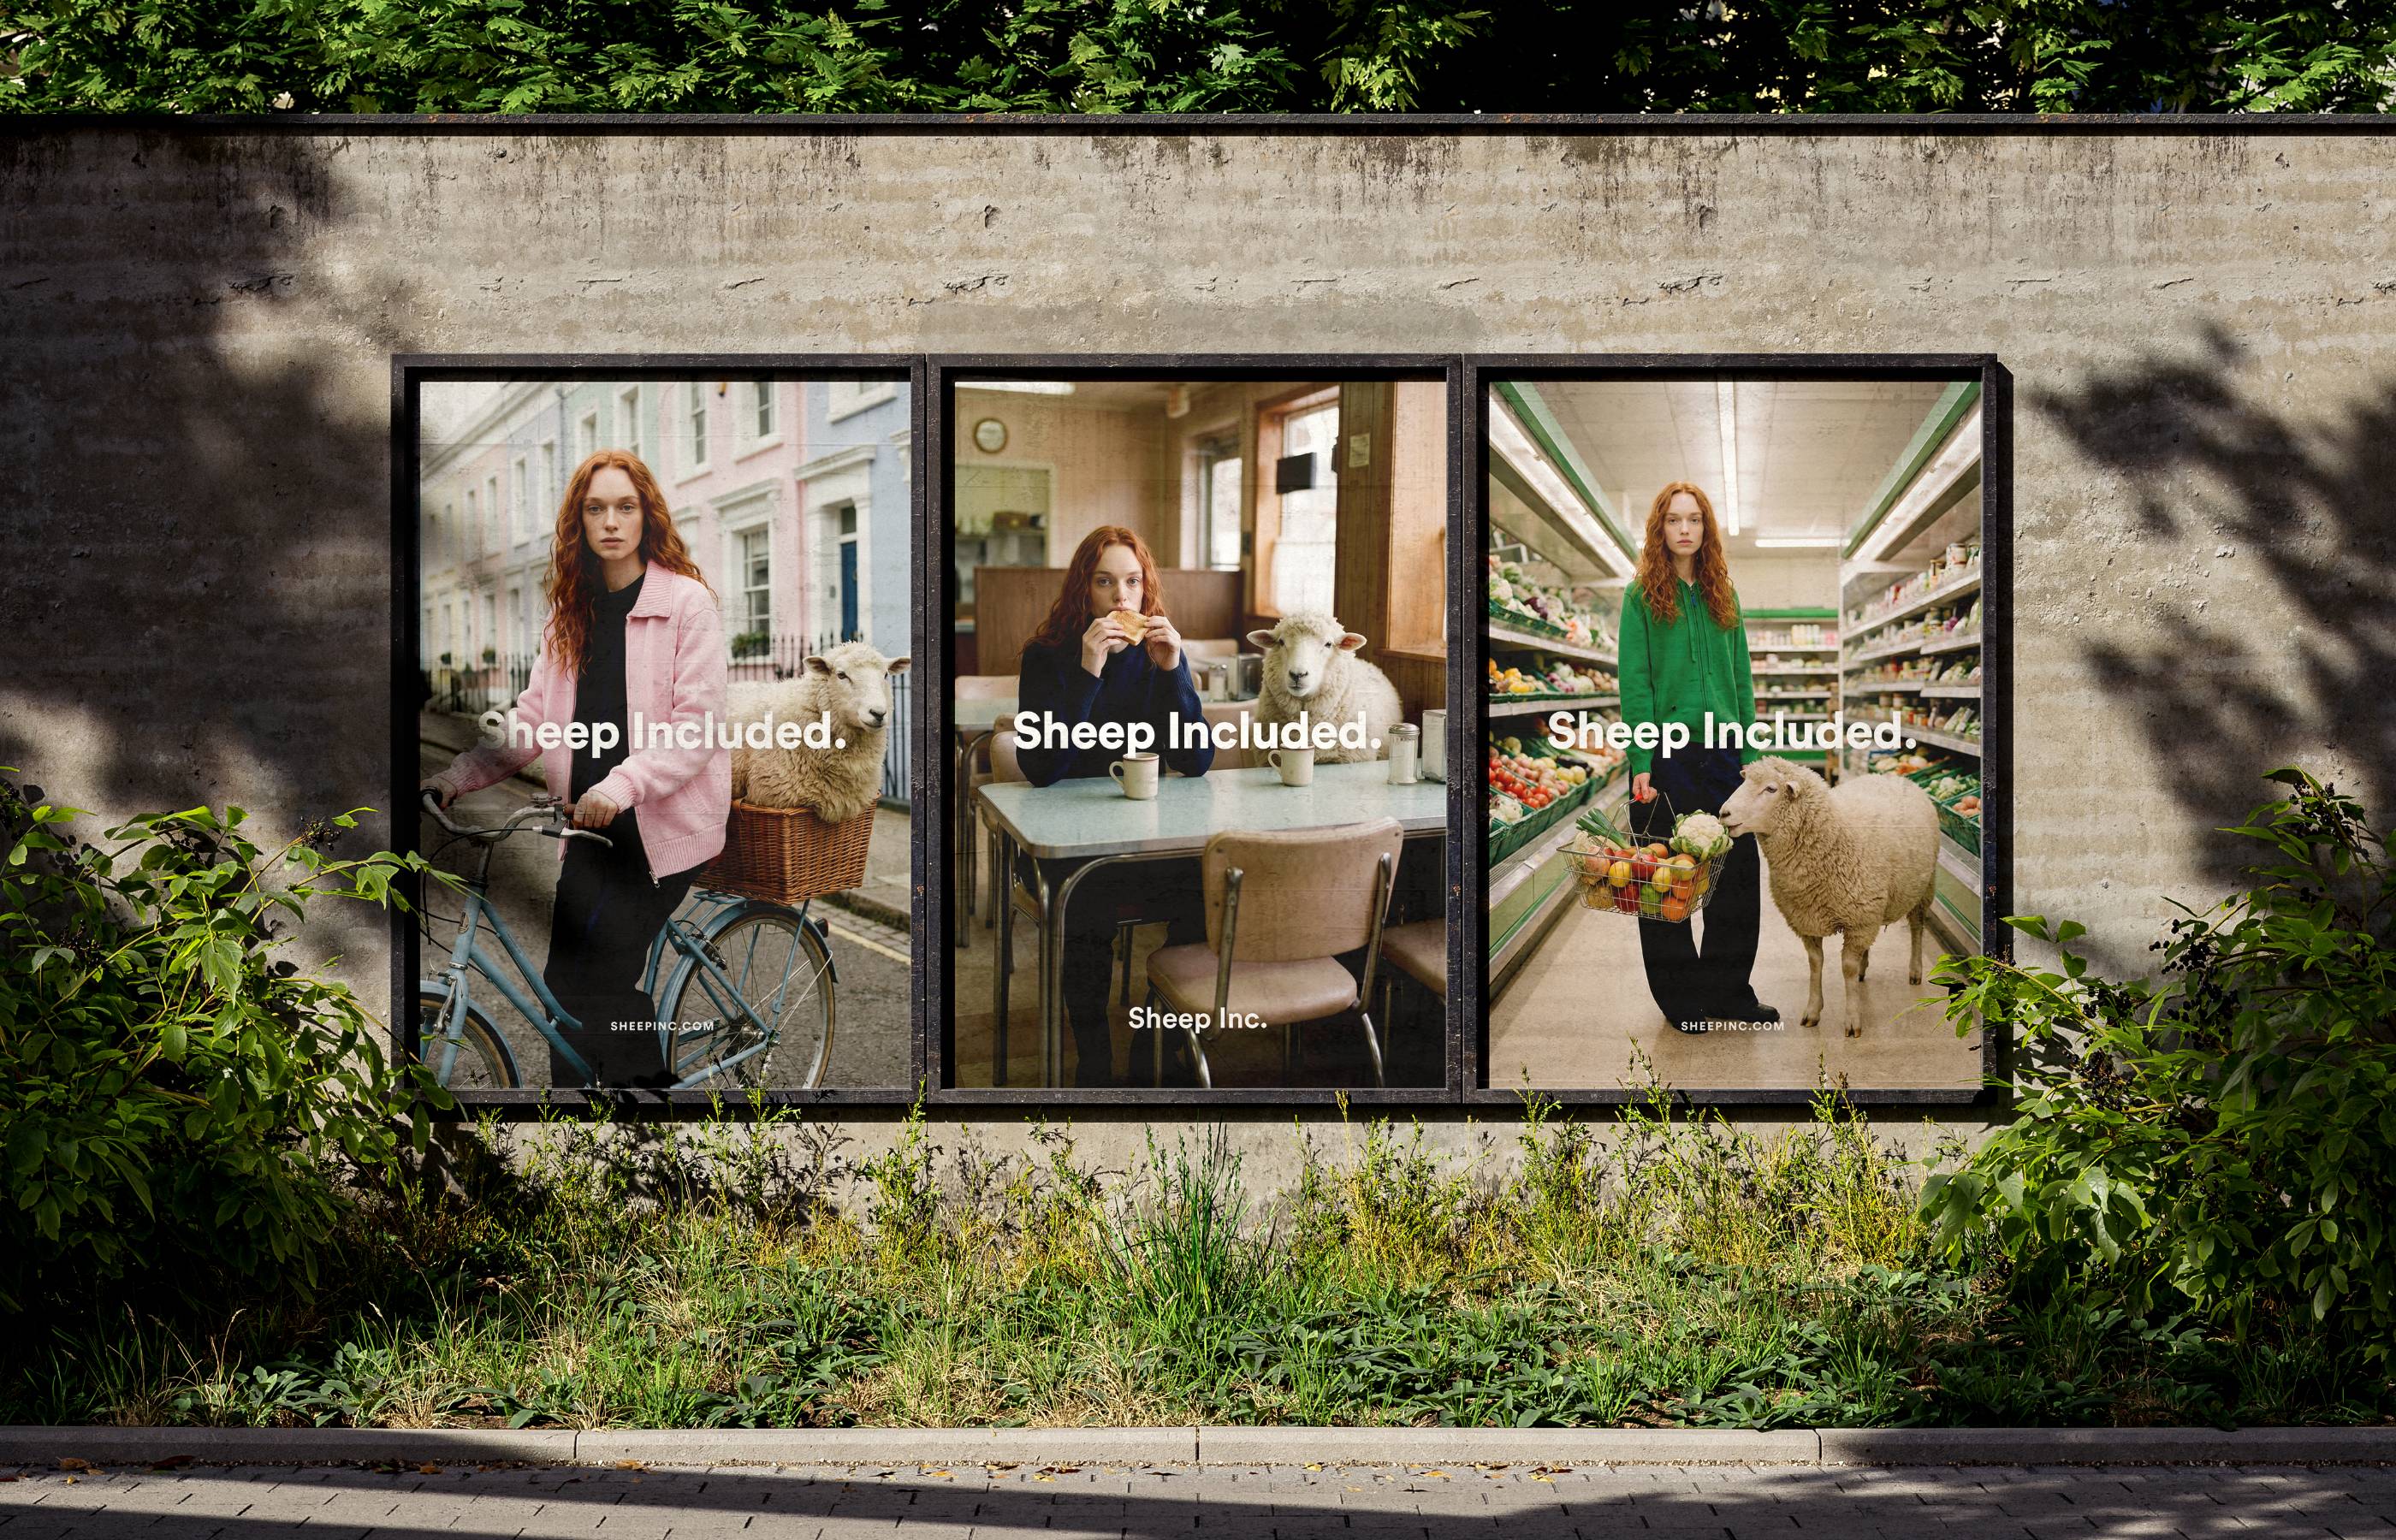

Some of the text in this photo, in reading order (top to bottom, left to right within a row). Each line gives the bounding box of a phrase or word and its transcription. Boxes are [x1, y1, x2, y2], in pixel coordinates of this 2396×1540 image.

[477, 710, 846, 758] Sheep Included.
[1012, 710, 1382, 757] Sheep Included.
[1547, 710, 1917, 759] Sheep Included.
[610, 1021, 715, 1031] SHEEPINC.COM
[1128, 1006, 1267, 1034] Sheep Inc.
[1681, 1021, 1785, 1031] SHEEPINC.COM
